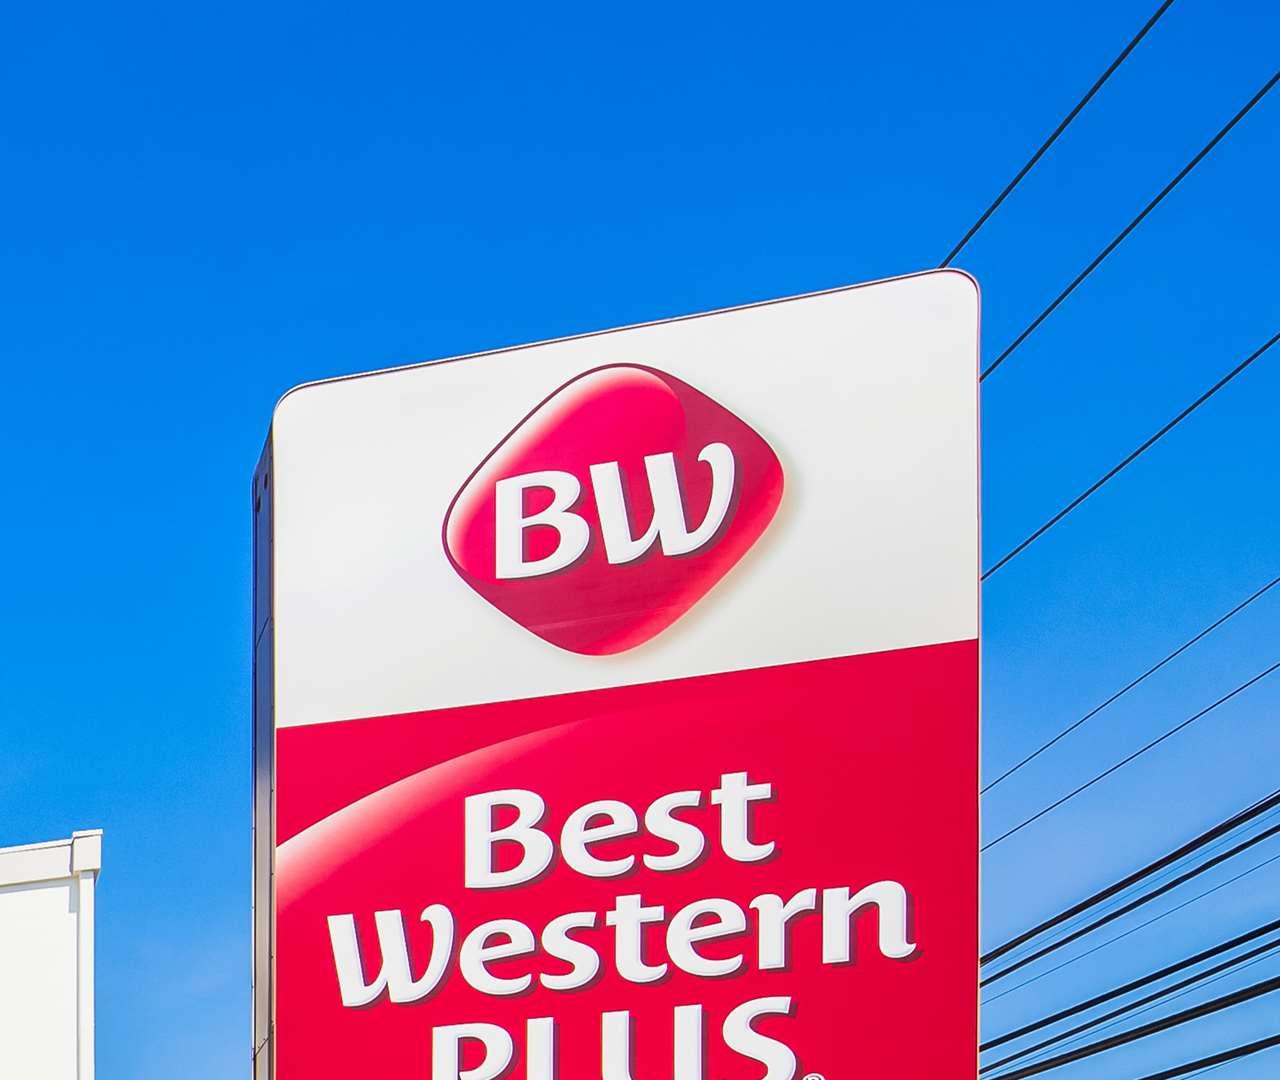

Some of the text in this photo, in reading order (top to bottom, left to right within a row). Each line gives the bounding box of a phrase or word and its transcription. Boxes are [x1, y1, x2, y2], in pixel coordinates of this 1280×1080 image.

[495, 443, 735, 579] BW
[465, 772, 775, 889] Best
[327, 880, 917, 1007] Western
